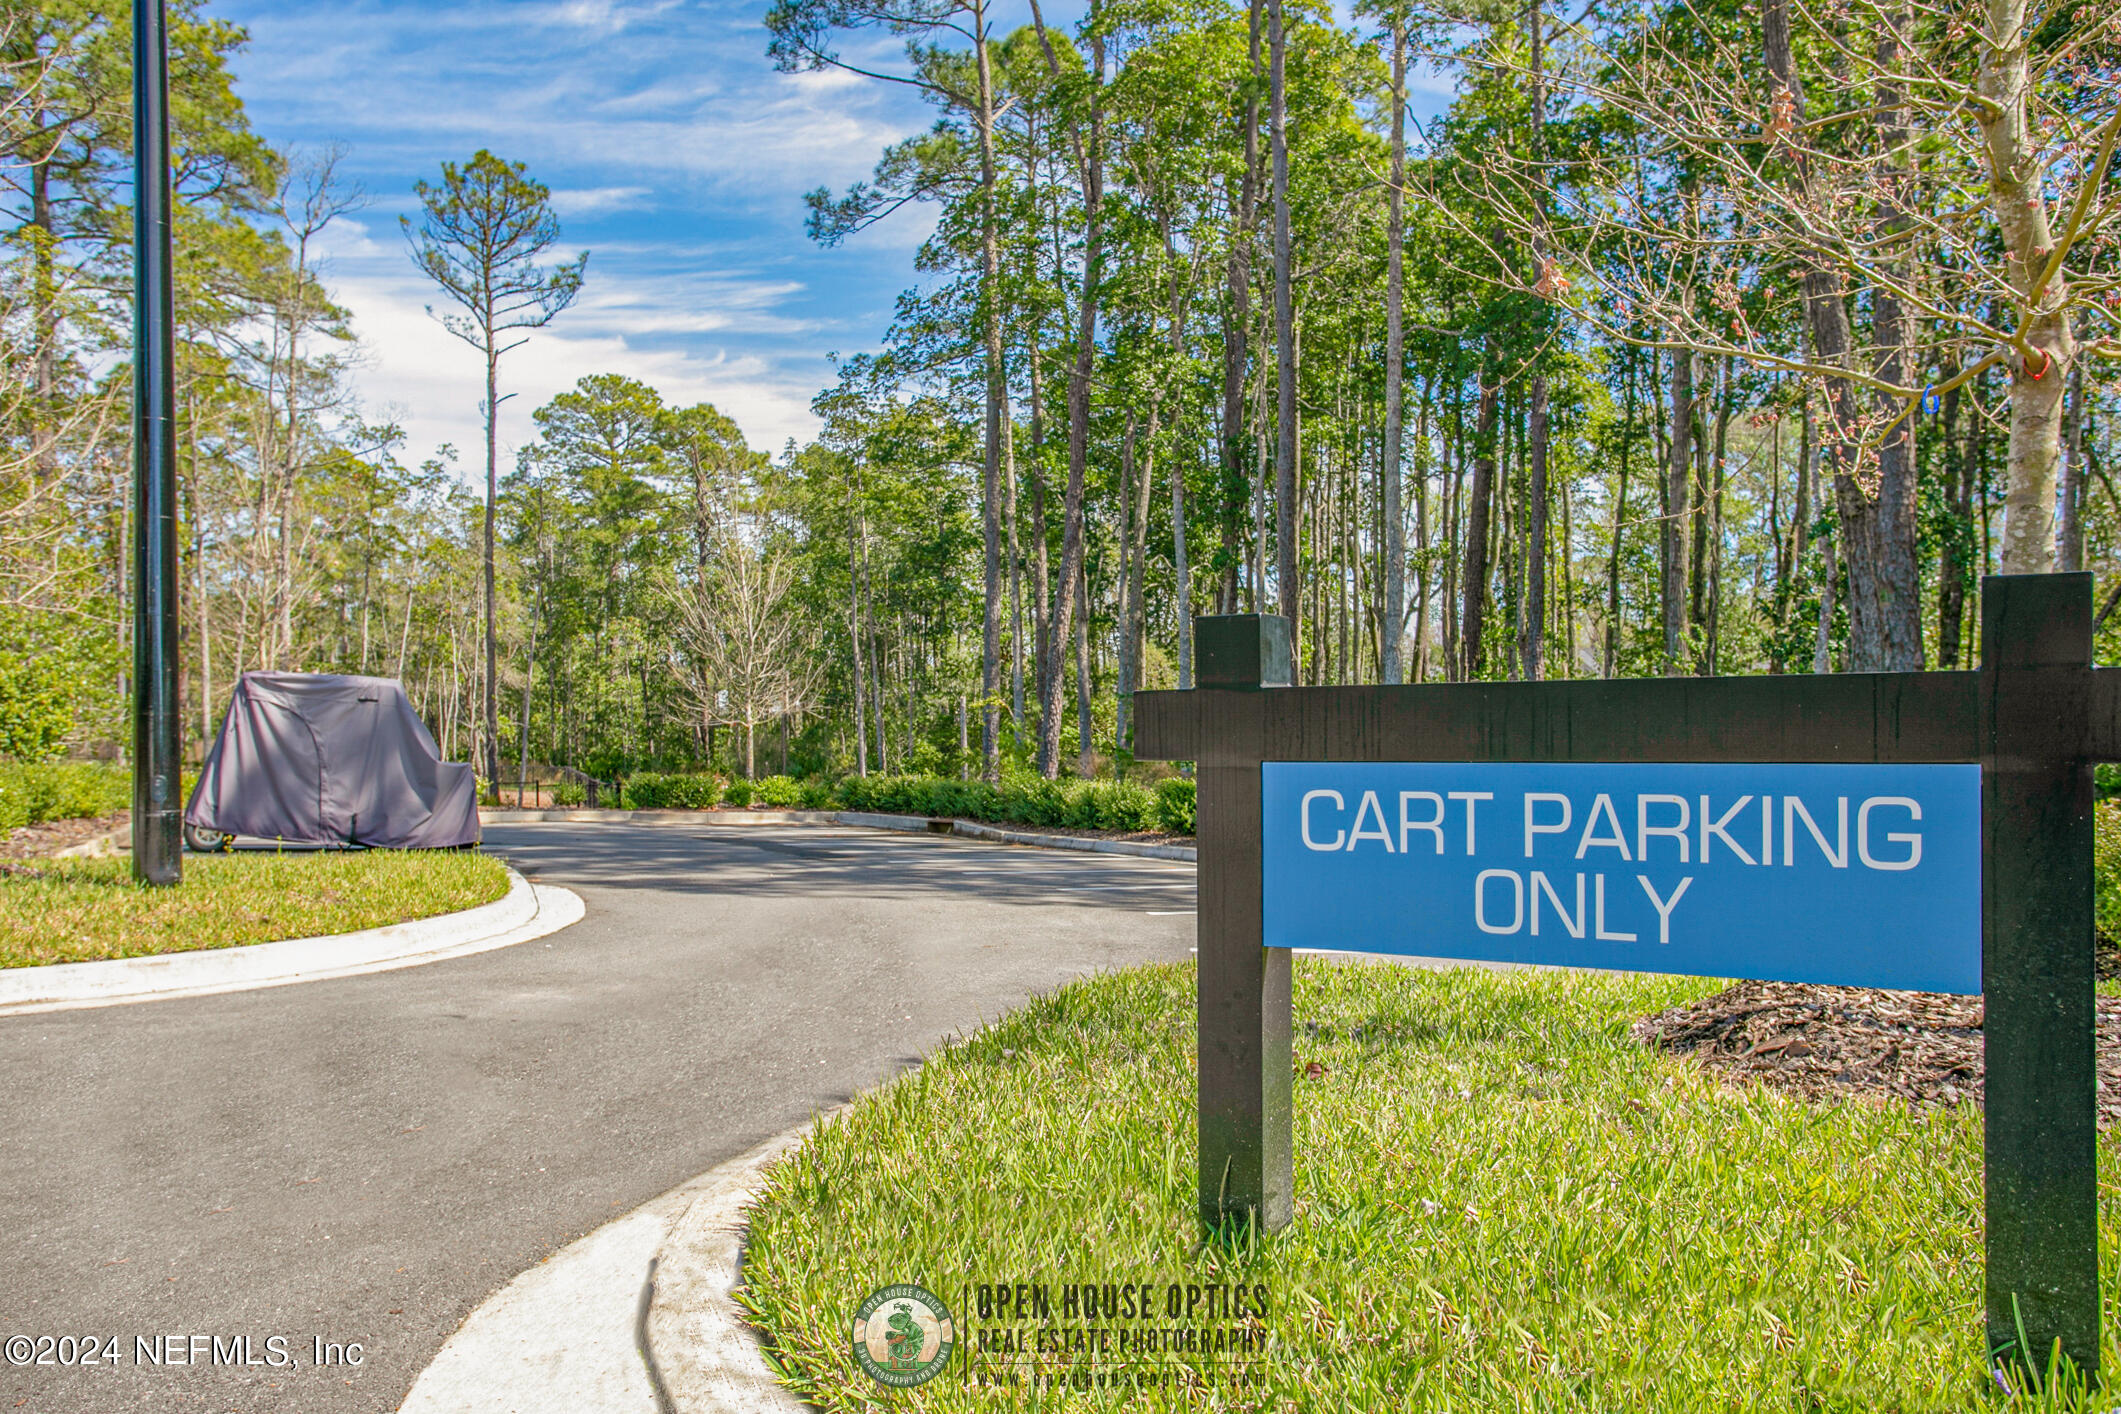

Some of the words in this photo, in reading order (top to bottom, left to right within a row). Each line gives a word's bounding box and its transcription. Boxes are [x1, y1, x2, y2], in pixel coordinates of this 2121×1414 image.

[1301, 789, 1494, 856] CART
[1524, 792, 1923, 871] PARKING
[1474, 869, 1694, 944] ONLY
